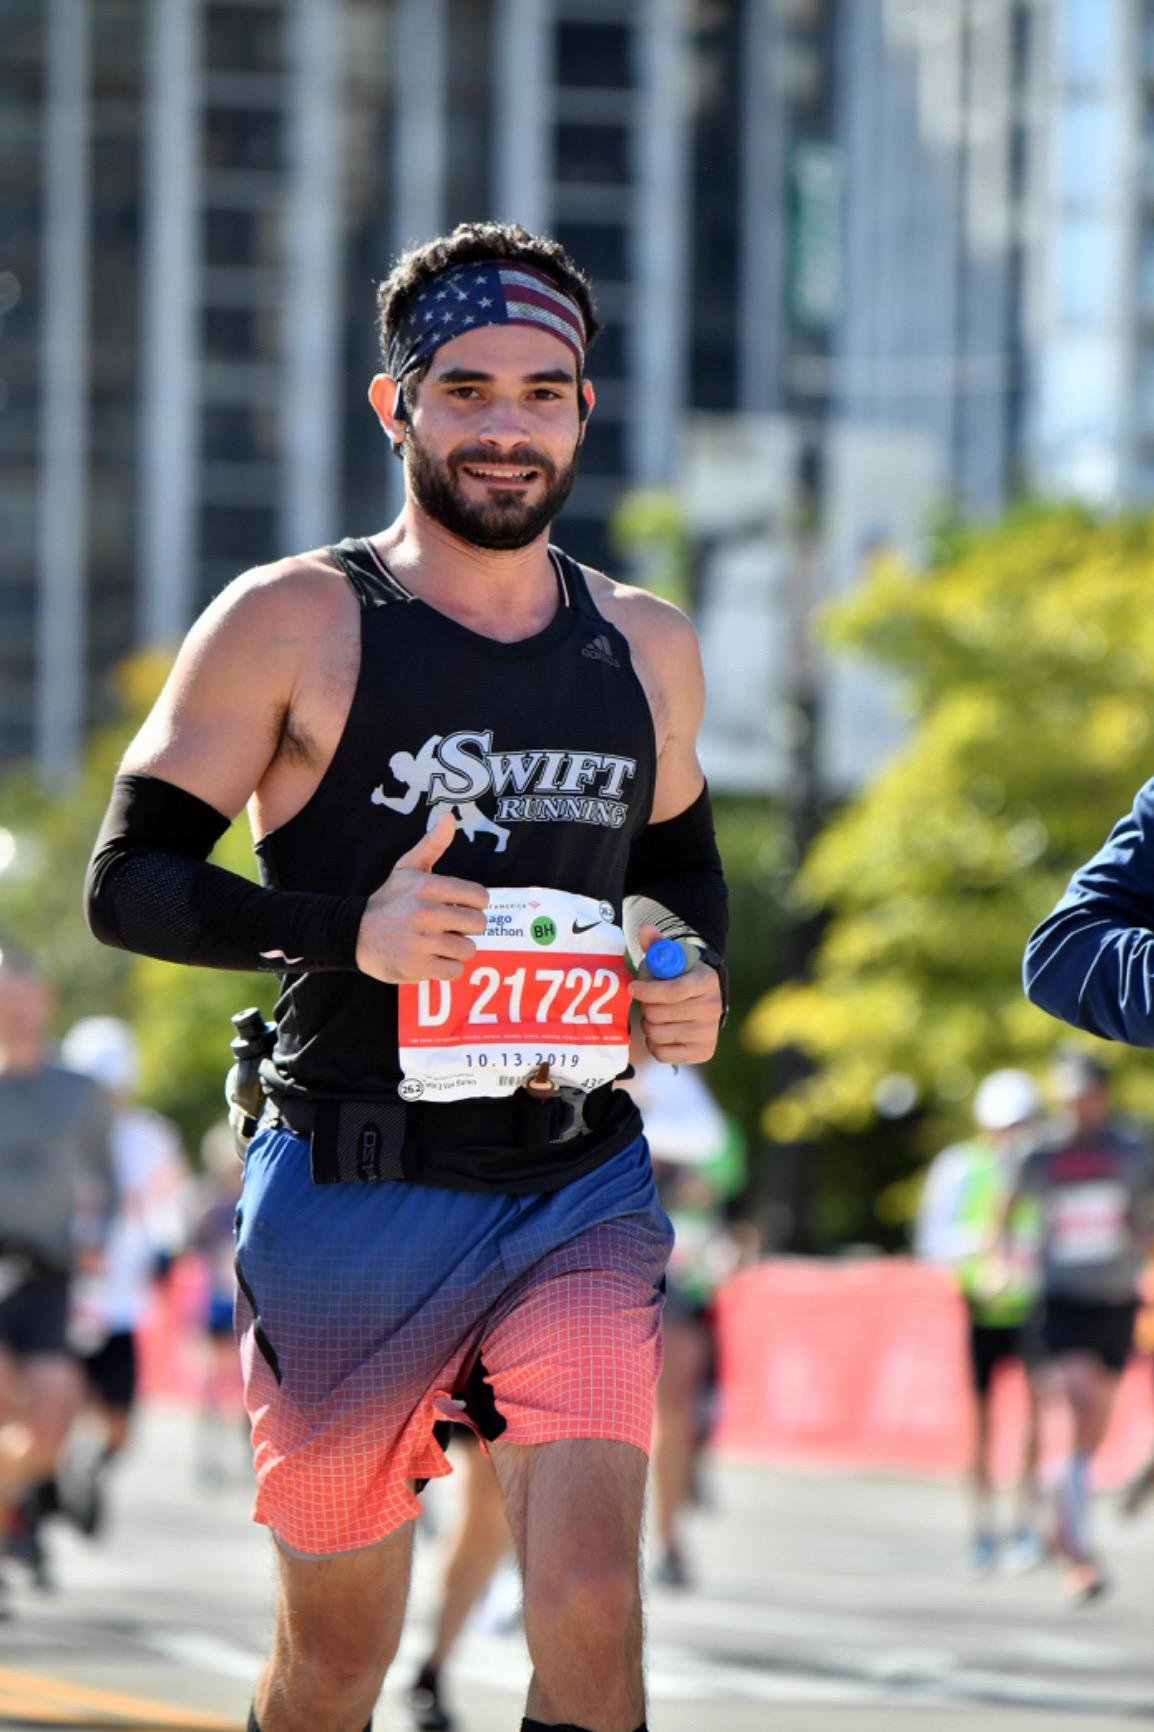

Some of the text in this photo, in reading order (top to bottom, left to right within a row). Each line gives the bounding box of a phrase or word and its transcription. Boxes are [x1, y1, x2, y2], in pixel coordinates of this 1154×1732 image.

[493, 794, 629, 829] RUNNING
[534, 923, 555, 938] BH
[417, 966, 620, 1027] D 21722
[465, 1052, 580, 1068] 10.13.2019
[402, 1083, 421, 1094] 26.2
